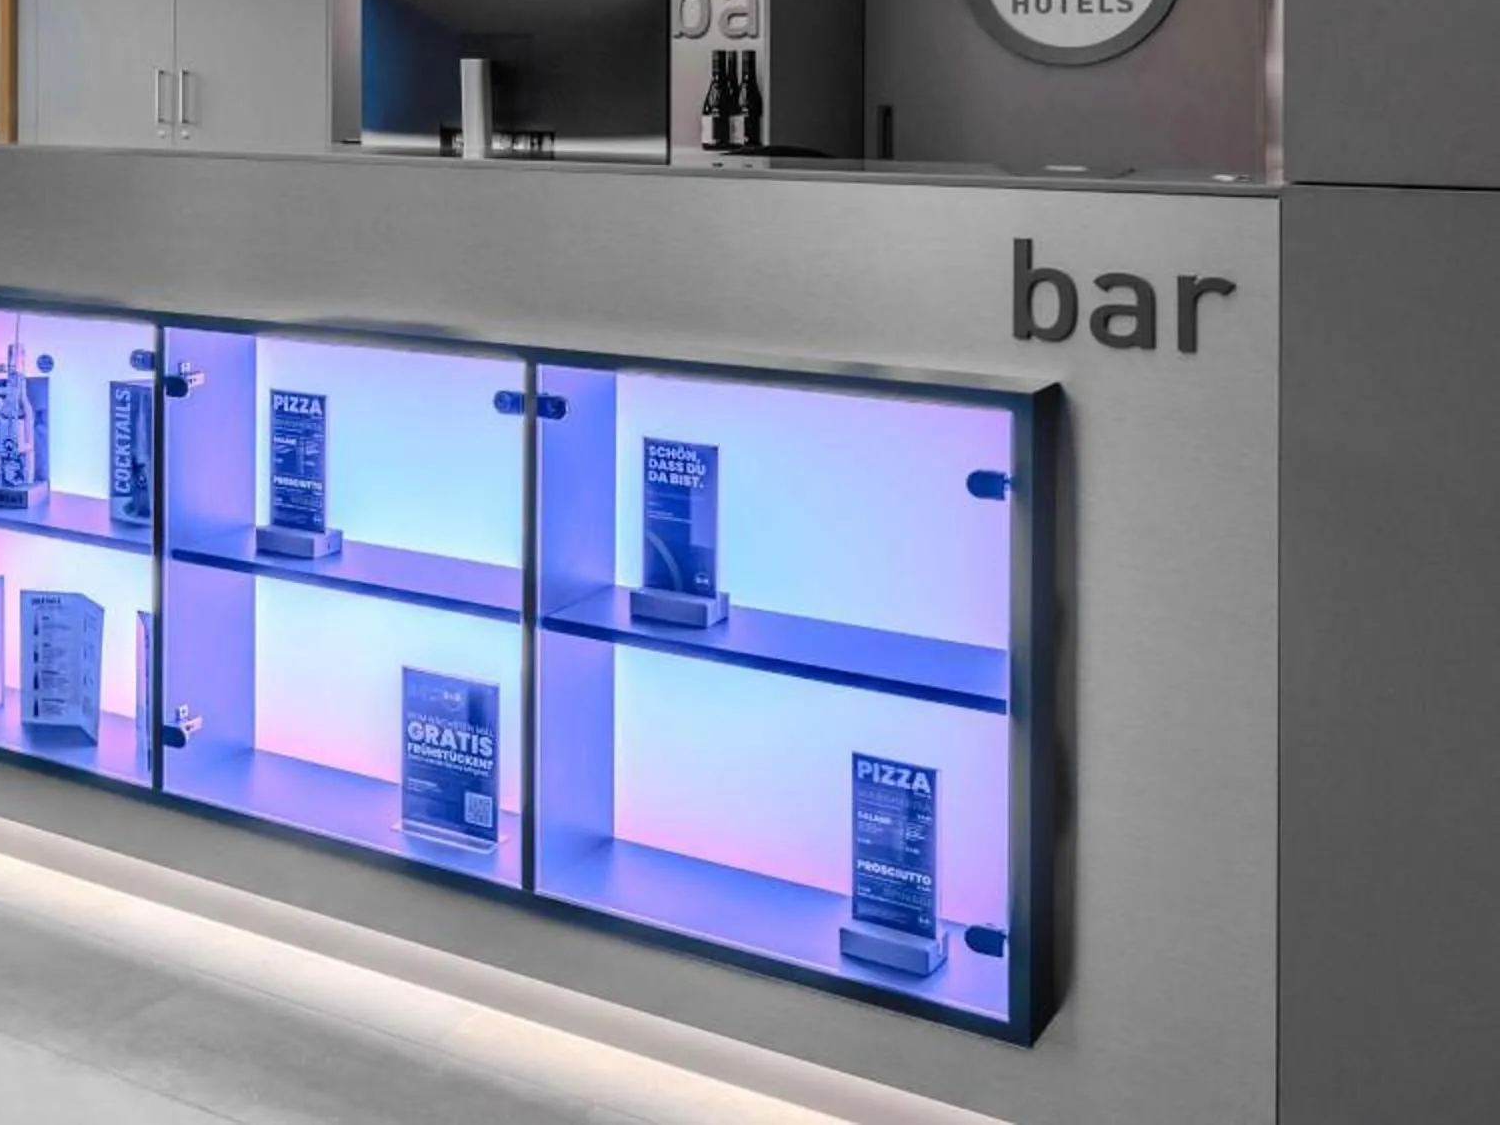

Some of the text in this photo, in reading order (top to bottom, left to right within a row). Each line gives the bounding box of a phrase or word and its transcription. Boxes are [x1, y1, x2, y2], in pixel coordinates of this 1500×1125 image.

[1012, 237, 1237, 354] bar
[273, 394, 323, 415] PIZZA
[115, 387, 131, 494] COCKTAILS
[648, 458, 707, 476] DASS DU
[648, 470, 668, 484] DA
[407, 721, 494, 757] GRATIS
[857, 759, 932, 794] PIZZA
[856, 859, 933, 886] PROSCIUTTO
